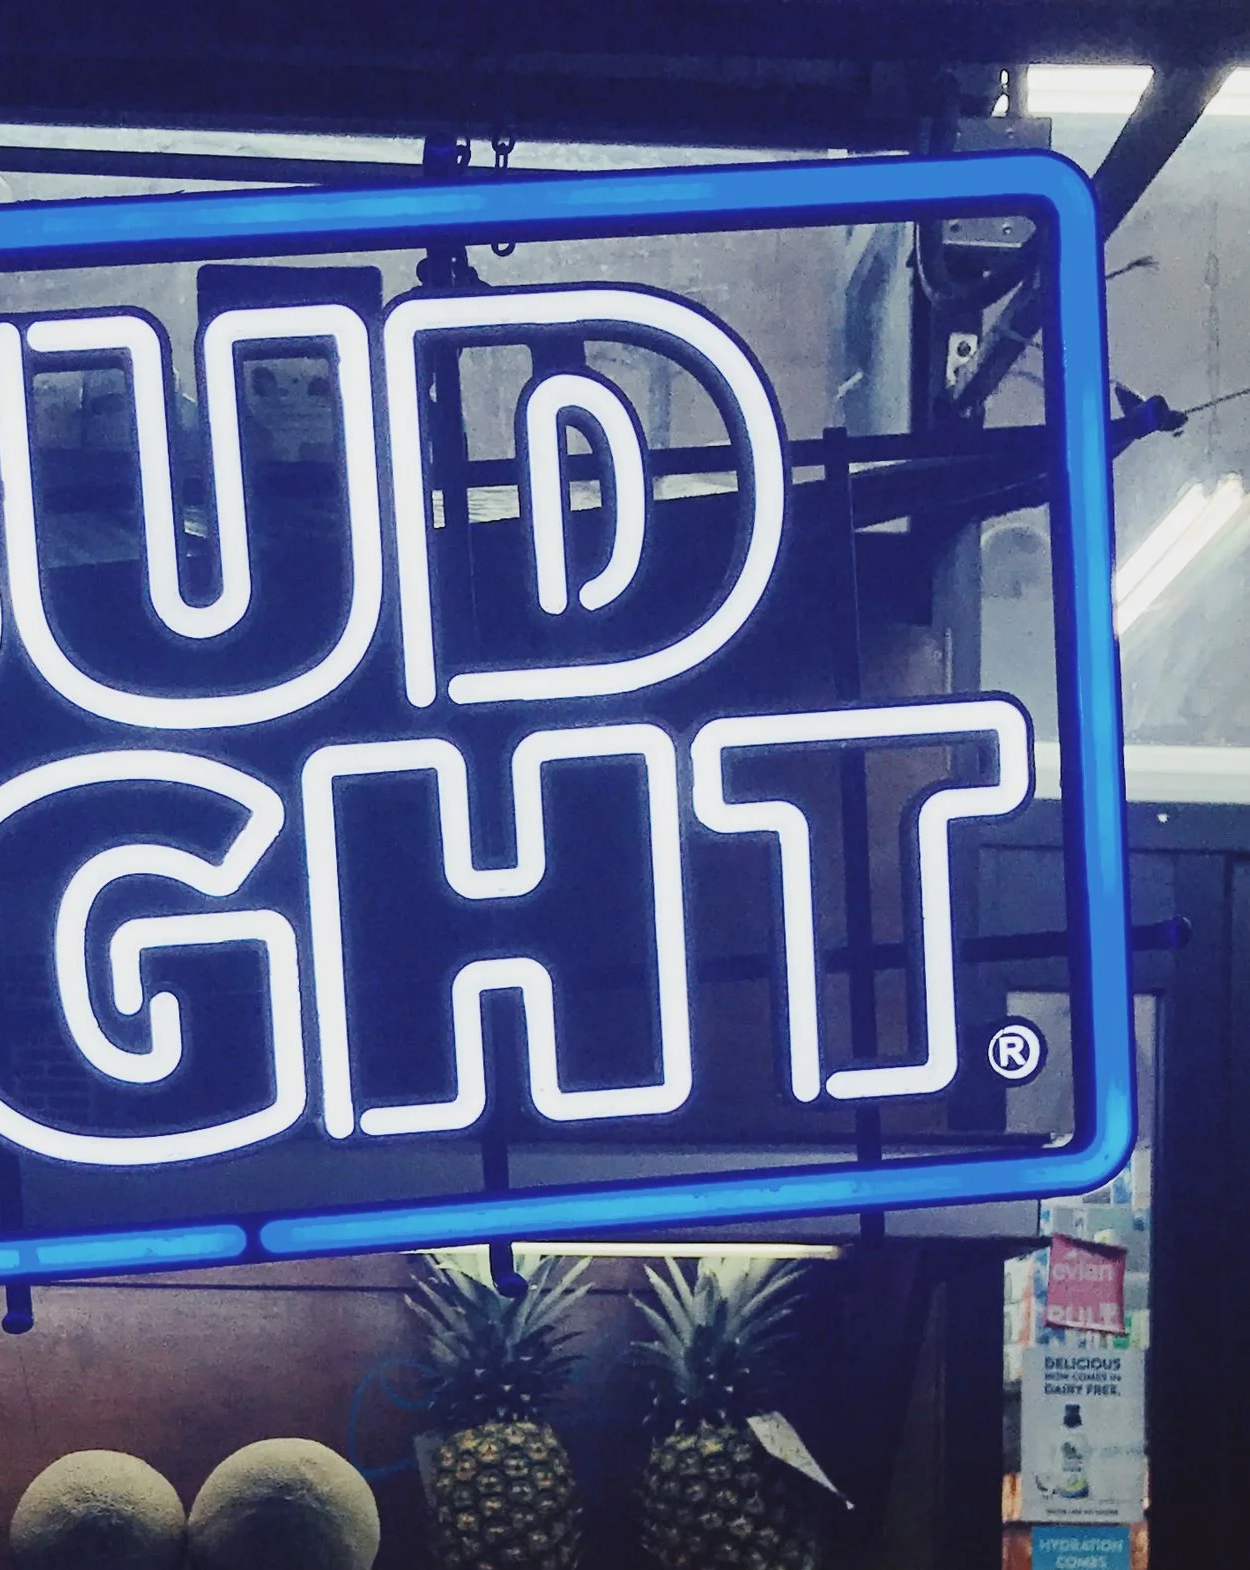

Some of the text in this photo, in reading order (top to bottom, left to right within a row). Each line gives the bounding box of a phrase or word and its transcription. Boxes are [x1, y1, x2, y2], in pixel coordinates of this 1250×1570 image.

[1044, 1356, 1121, 1371] DELICIOUS
[1072, 1373, 1107, 1382] COMES
[1044, 1383, 1082, 1395] DAIRY
[1038, 1537, 1124, 1553] HYDRATION
[1055, 1555, 1108, 1569] COMES
